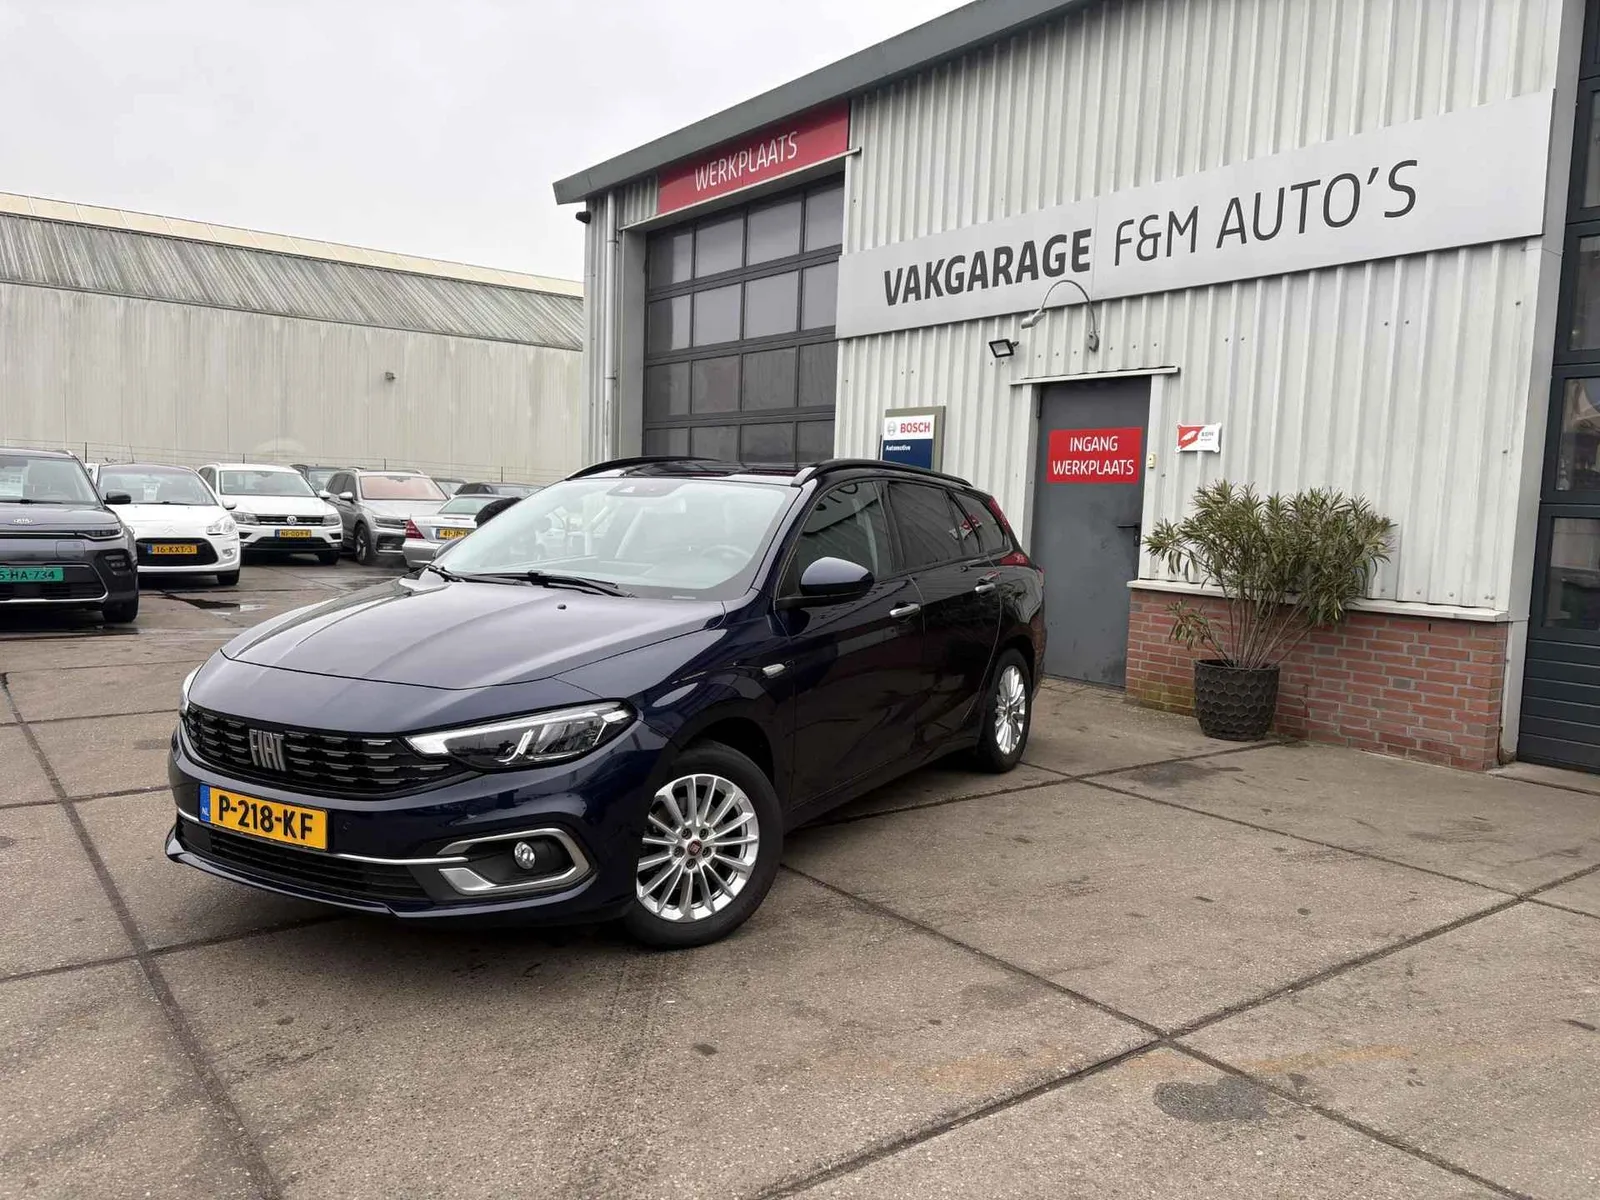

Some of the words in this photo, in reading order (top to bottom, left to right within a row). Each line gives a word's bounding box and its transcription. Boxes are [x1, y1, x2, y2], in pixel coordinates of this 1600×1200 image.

[694, 130, 799, 192] WERKPLAATS
[883, 228, 1093, 306] VAKGARAGE
[1113, 204, 1200, 267] F&M
[1215, 159, 1418, 249] AUTO'S
[900, 421, 931, 434] BOSCH
[1069, 436, 1119, 453] INGANG
[1052, 459, 1135, 476] WERKPLAATS
[249, 728, 286, 772] FIAT
[201, 806, 210, 817] NL
[218, 794, 313, 840] P-218-KF
